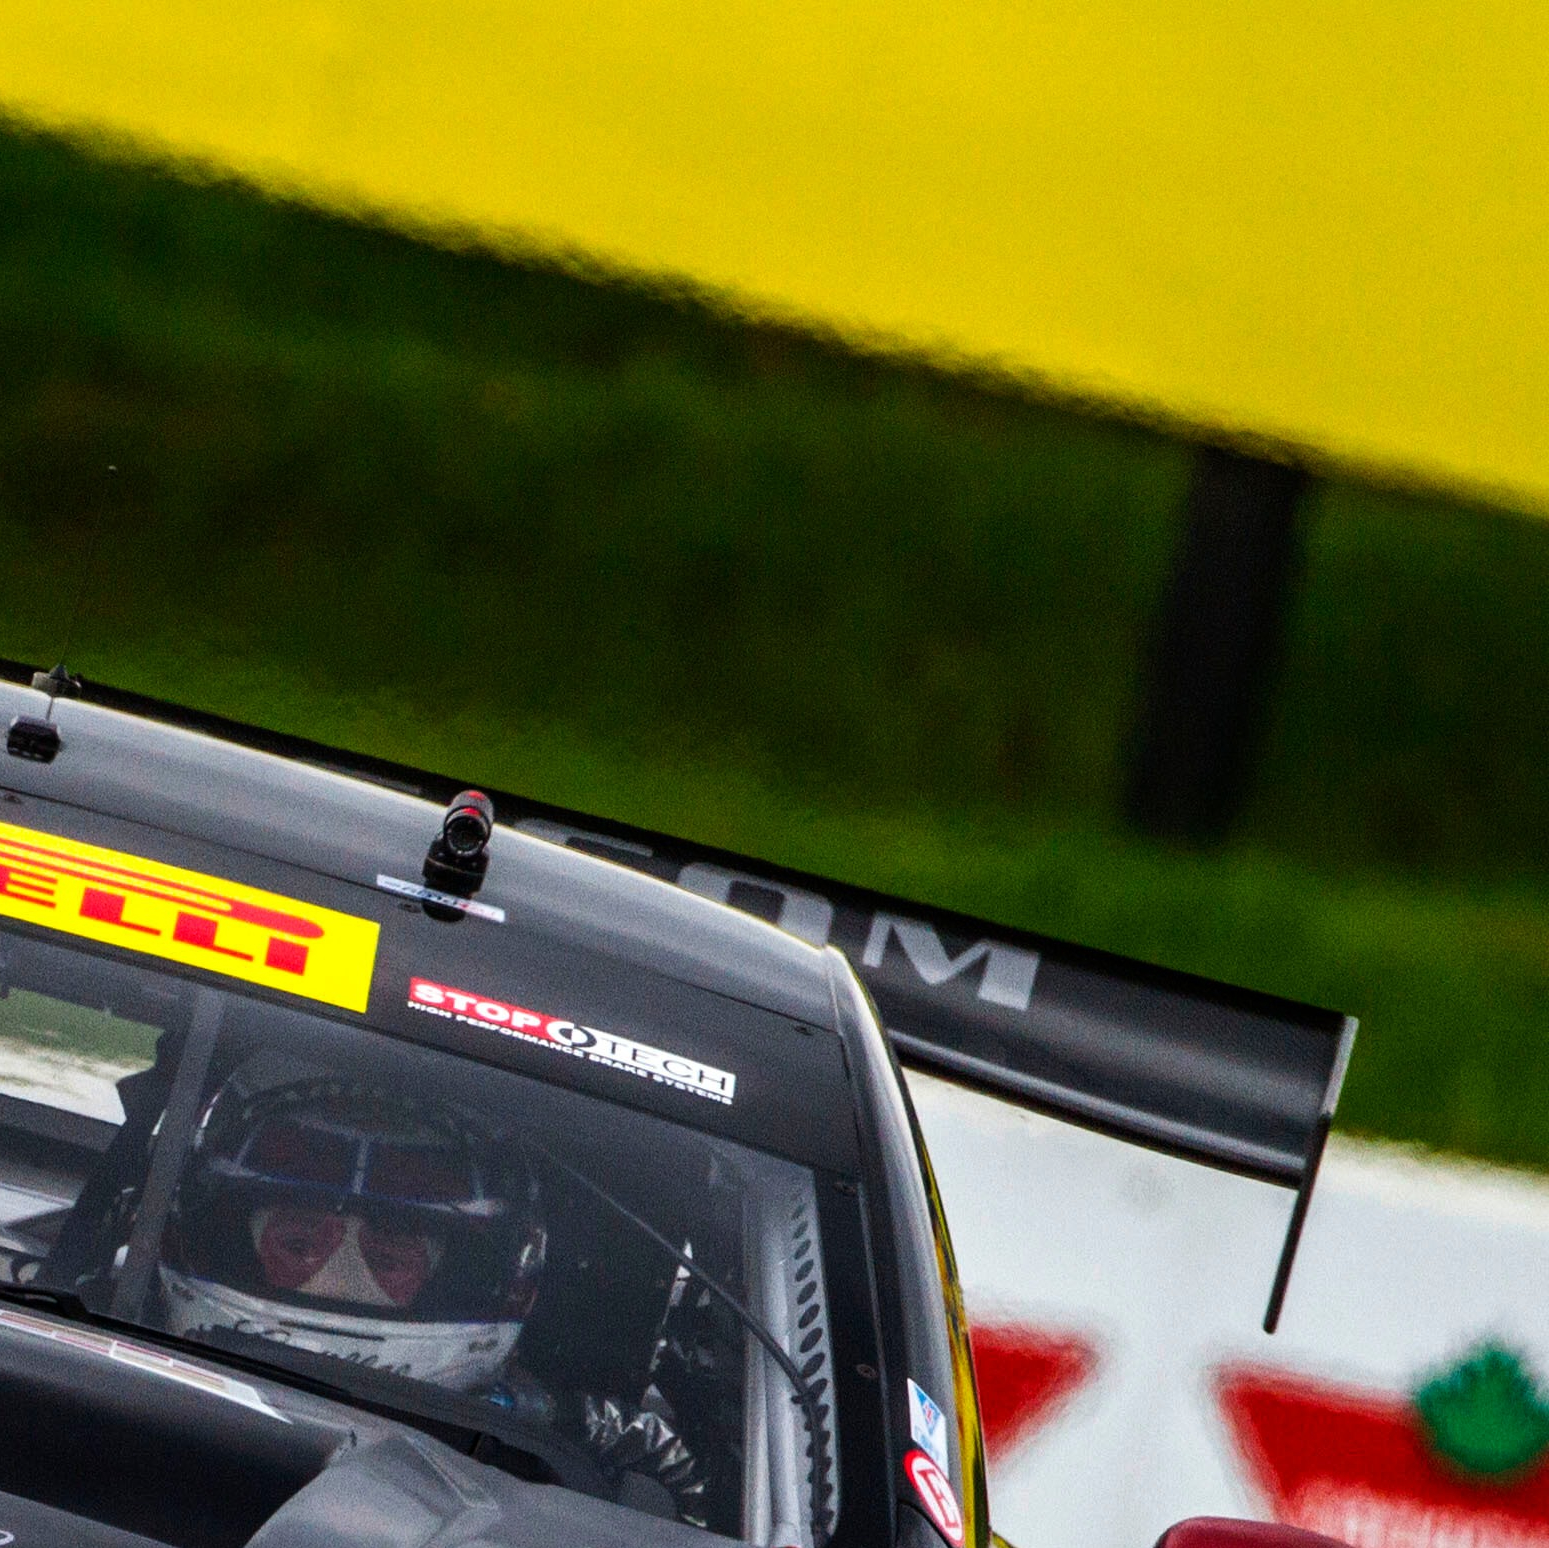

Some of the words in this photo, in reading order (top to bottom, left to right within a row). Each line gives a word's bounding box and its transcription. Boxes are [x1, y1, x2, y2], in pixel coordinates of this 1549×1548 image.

[407, 1000, 452, 1019] HIGH
[455, 1013, 585, 1059] PERFORMANCE
[588, 1053, 649, 1079] BRAKE
[652, 1073, 733, 1106] SYSTEMS
[414, 983, 541, 1029] STOP
[600, 1035, 728, 1092] TECH
